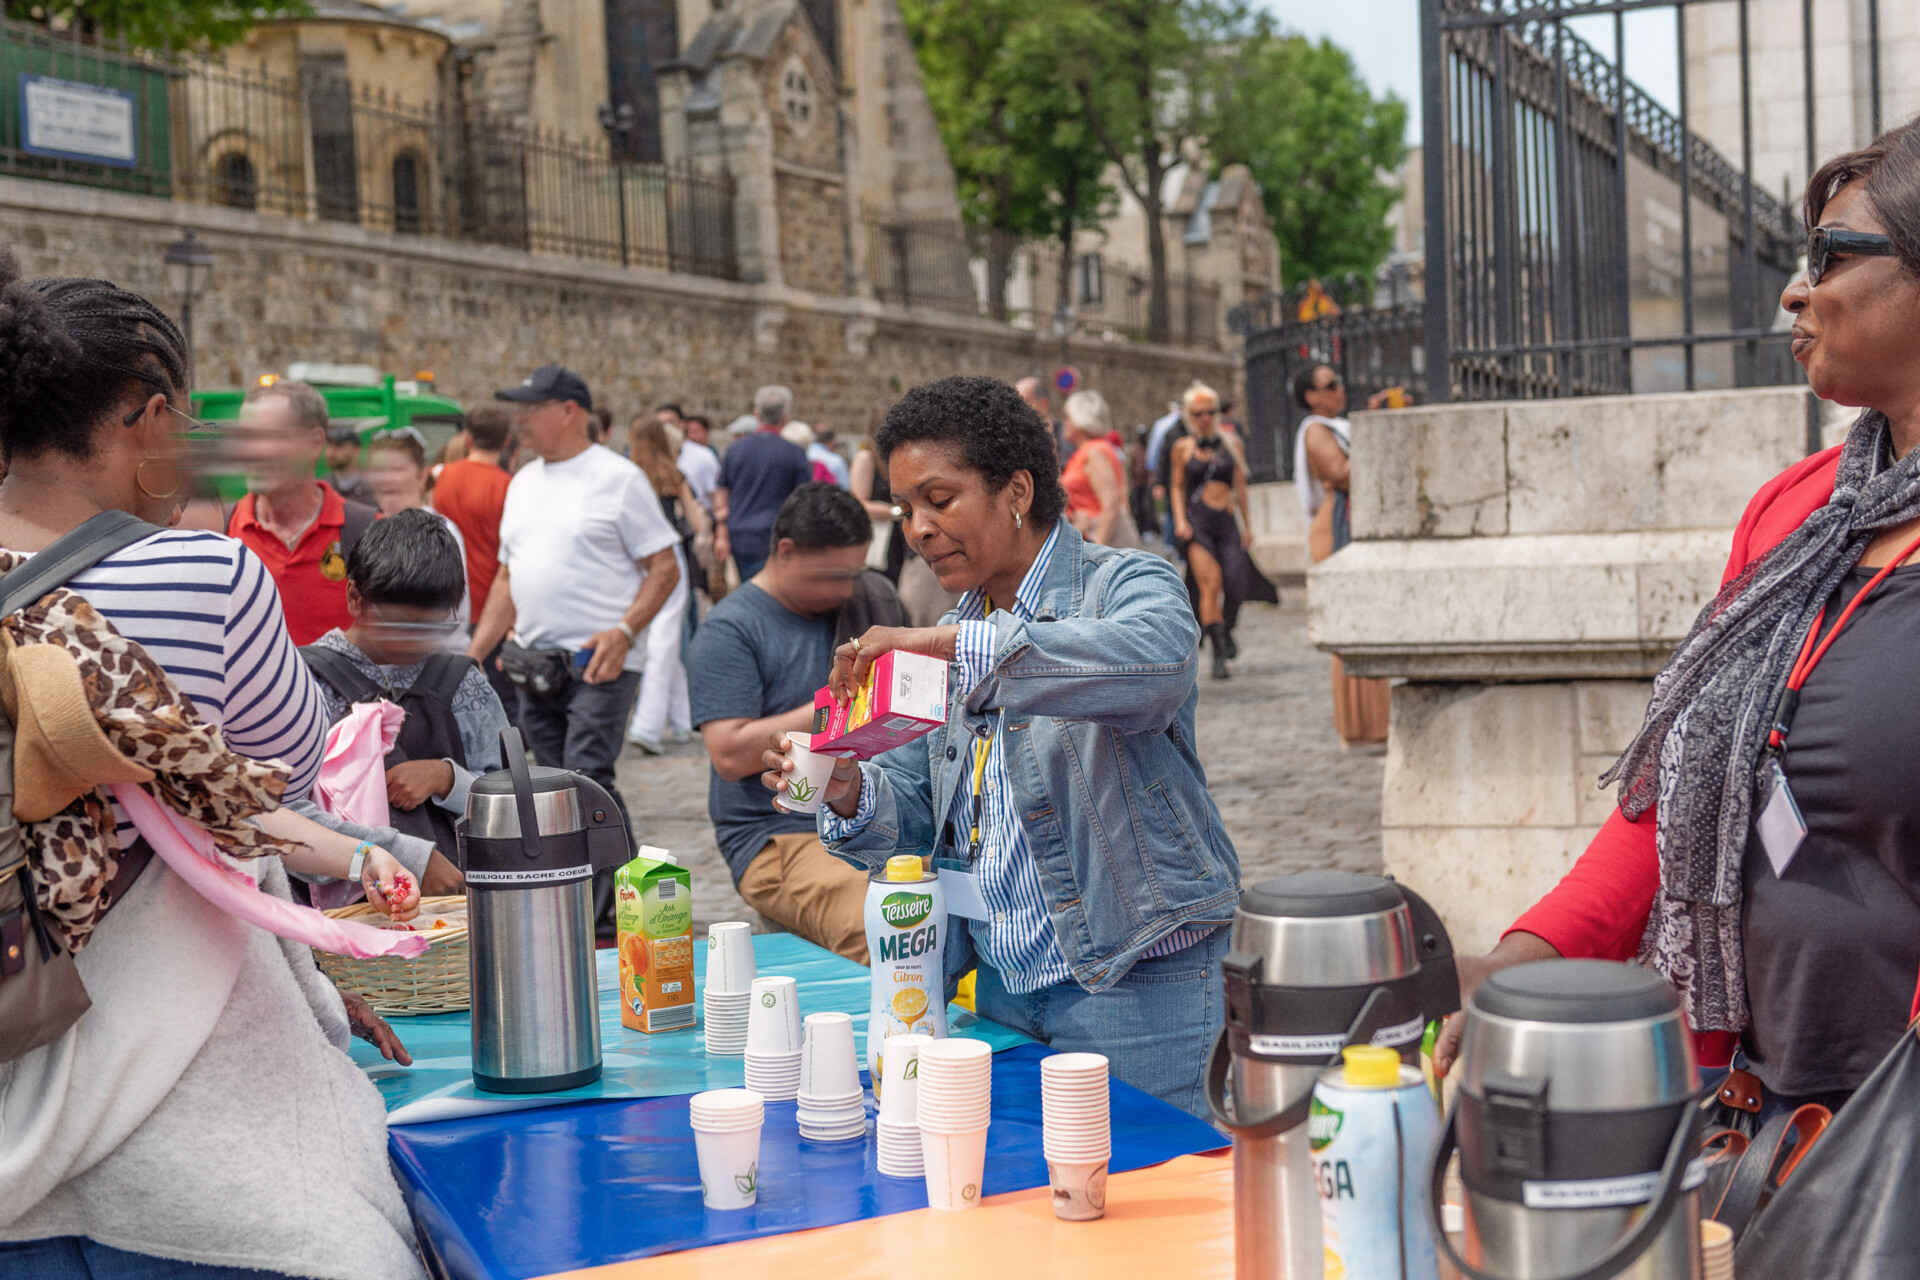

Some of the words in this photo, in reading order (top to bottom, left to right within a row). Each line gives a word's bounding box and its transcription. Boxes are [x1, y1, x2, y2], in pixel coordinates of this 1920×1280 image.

[468, 872, 513, 880] BASILIQUE
[559, 868, 587, 877] COEUR
[659, 902, 675, 915] Jus
[881, 896, 930, 922] Teisseire
[650, 911, 688, 925] d'Orange
[879, 923, 936, 963] MEGA
[893, 970, 924, 983] Citron
